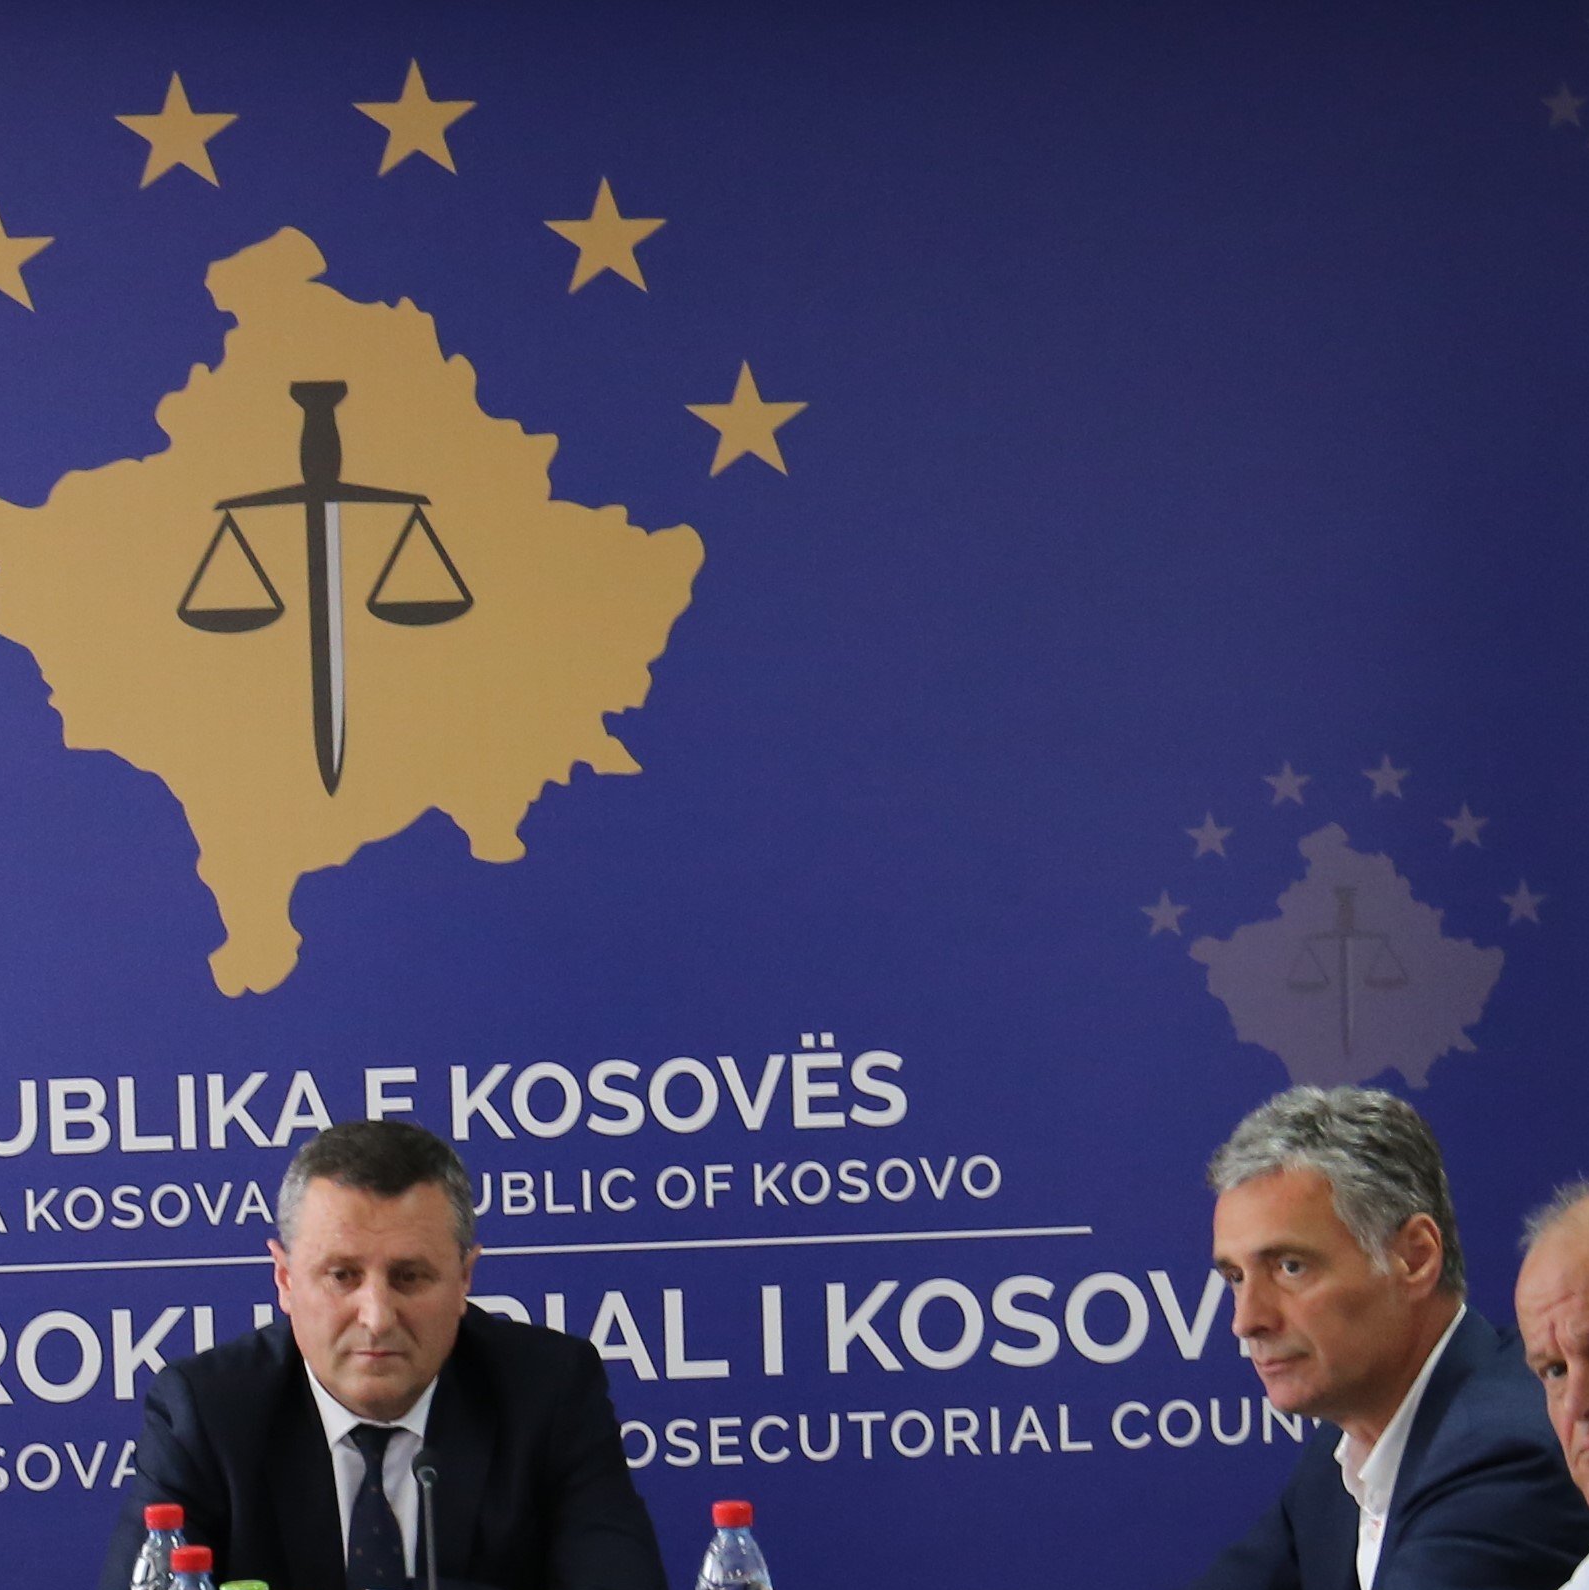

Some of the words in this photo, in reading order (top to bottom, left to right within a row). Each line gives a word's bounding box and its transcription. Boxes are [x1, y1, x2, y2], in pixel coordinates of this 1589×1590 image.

[449, 1032, 909, 1142] KOSOVËS
[24, 1180, 275, 1234] KOSOVA
[655, 1163, 733, 1210] OF
[753, 1154, 1003, 1206] KOSOVO
[761, 1284, 785, 1376] I
[826, 1267, 1252, 1375] KOSOV
[620, 1403, 1093, 1469] OSECUTORIAL
[1111, 1396, 1322, 1450] COUN
